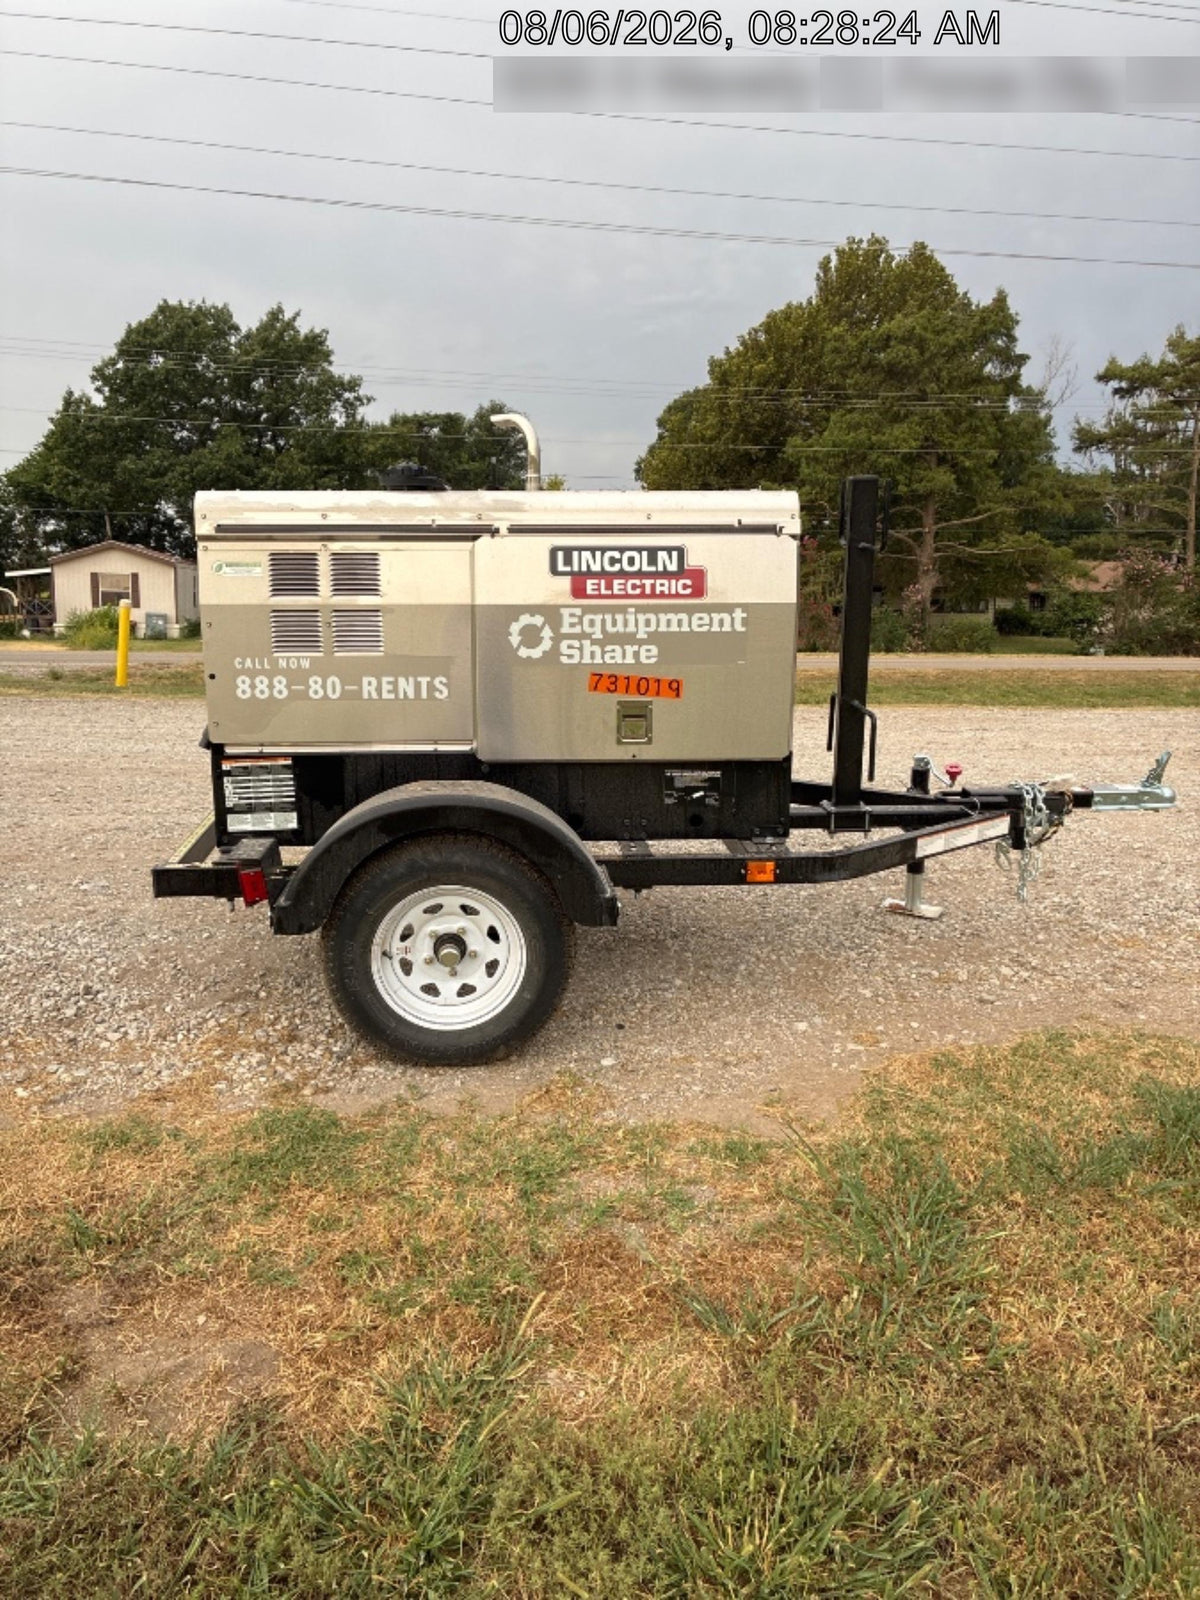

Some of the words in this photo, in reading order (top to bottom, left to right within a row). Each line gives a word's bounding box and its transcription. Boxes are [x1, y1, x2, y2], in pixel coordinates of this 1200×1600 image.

[556, 550, 679, 572] LINCOLN
[585, 578, 693, 596] ELECTRIC
[559, 607, 748, 639] Equipment
[233, 657, 271, 670] CALL
[278, 657, 312, 670] NOW
[559, 639, 659, 664] Share
[235, 675, 450, 701] 888-80-RENTS
[591, 673, 682, 698] 731019
